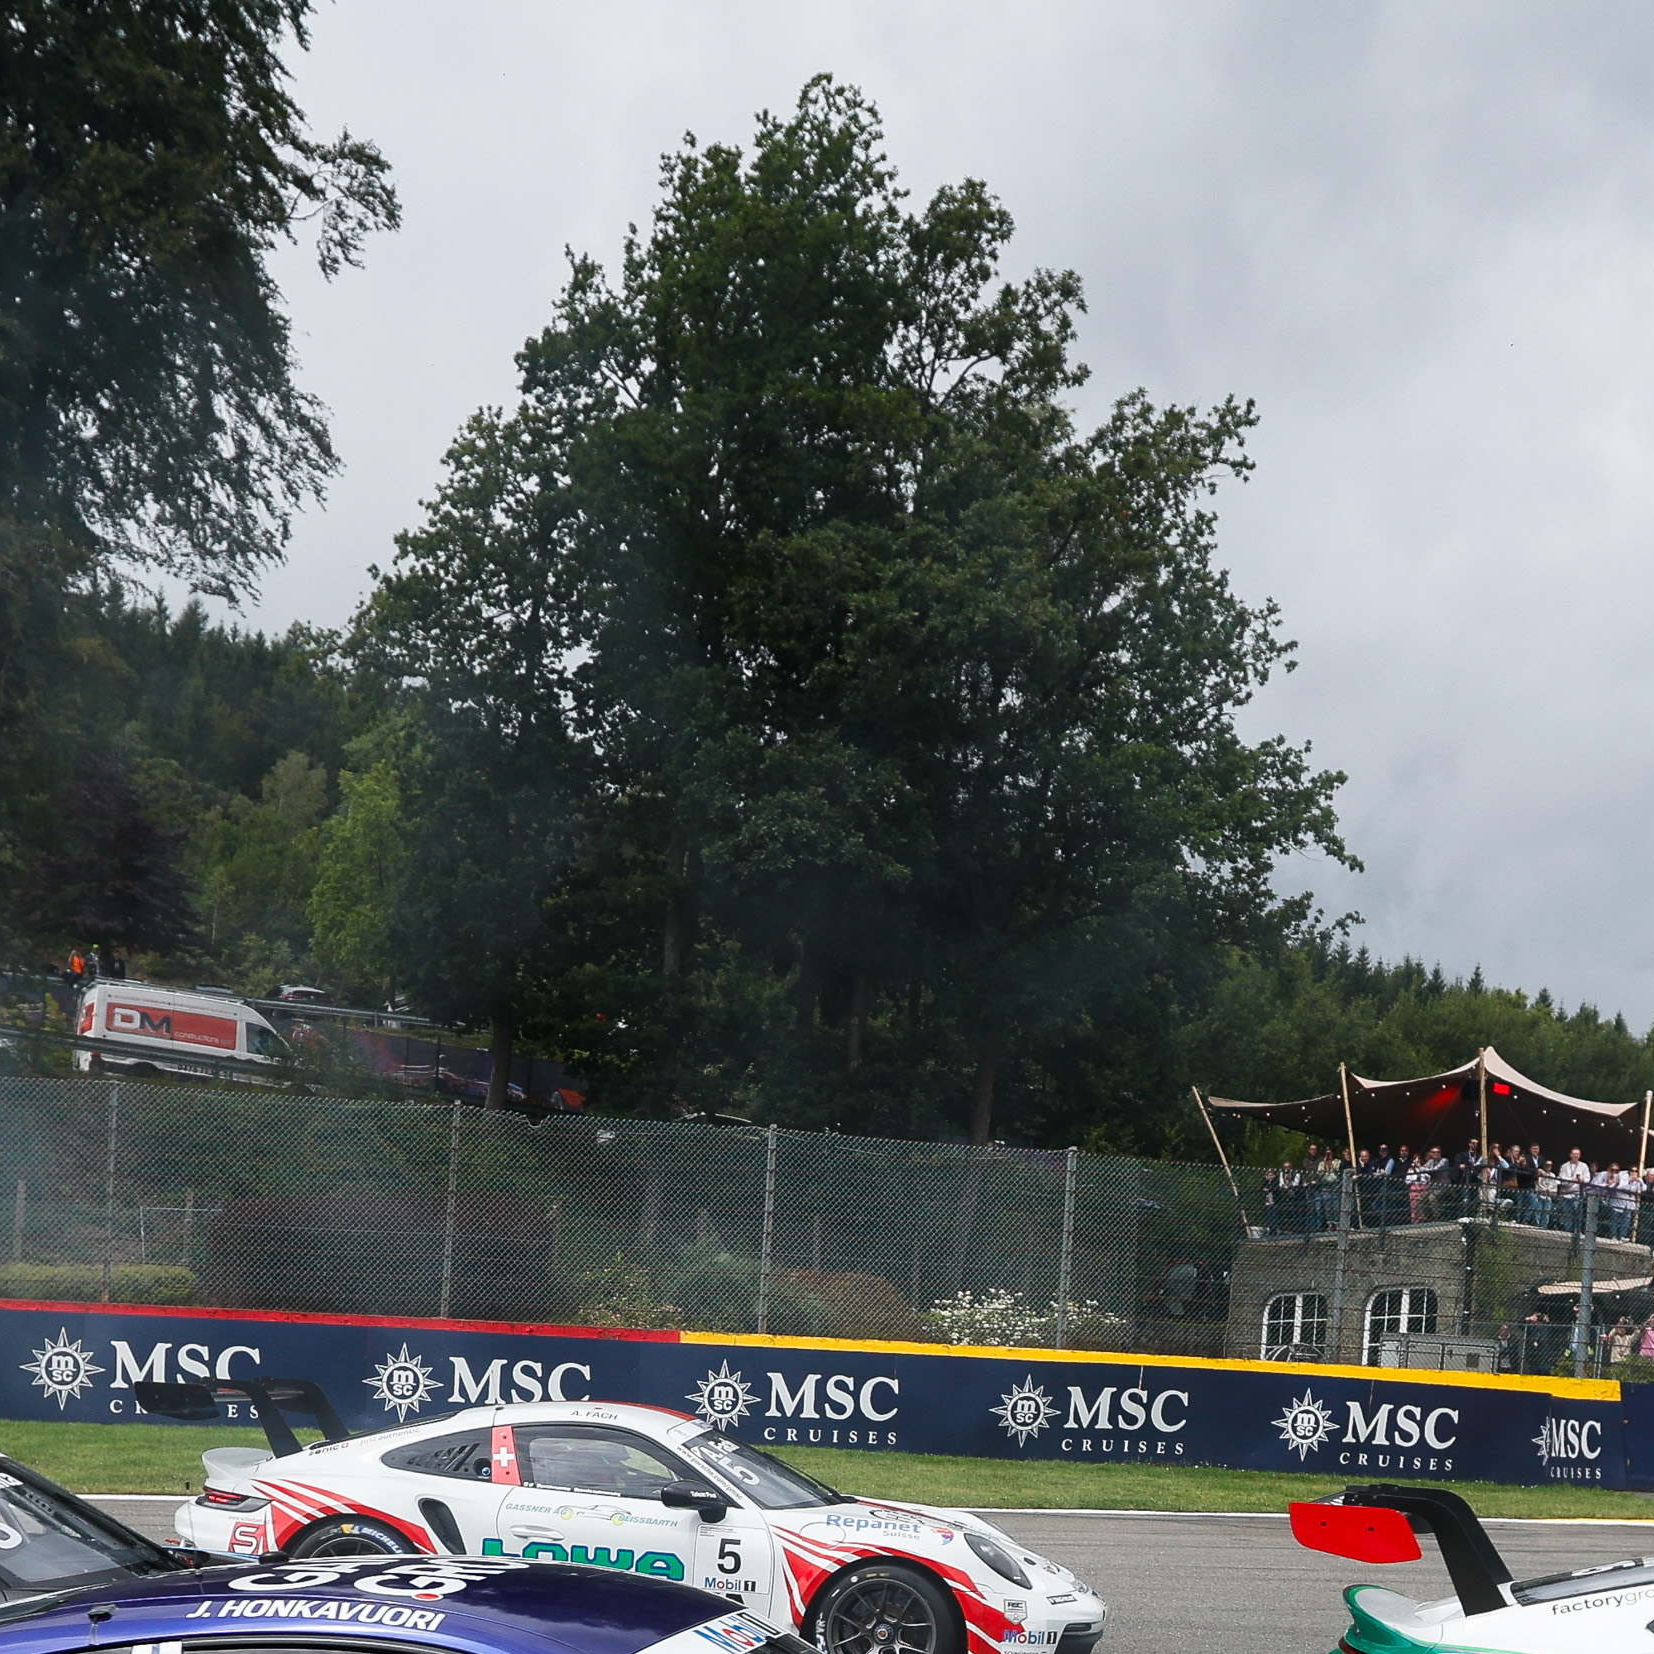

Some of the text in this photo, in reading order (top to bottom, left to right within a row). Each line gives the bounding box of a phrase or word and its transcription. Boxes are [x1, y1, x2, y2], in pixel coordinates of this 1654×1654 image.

[113, 1007, 172, 1035] DM
[110, 1340, 261, 1388] MSC
[448, 1357, 590, 1401] MSC
[765, 1373, 898, 1421] MSC
[585, 1410, 619, 1420] FACH
[1064, 1384, 1188, 1432] MSC
[1342, 1402, 1458, 1449] MSC
[764, 1428, 896, 1444] CRUISES
[1552, 1418, 1601, 1459] MSC
[1062, 1439, 1183, 1454] CRUISES
[1340, 1453, 1452, 1470] CRUISES
[1551, 1467, 1601, 1479] CRUISES
[505, 1502, 551, 1514] GASSNER
[826, 1514, 922, 1533] Repanet
[882, 1529, 921, 1541] Suisse
[717, 1538, 742, 1575] 5
[704, 1577, 756, 1592] Mobil 1
[186, 1599, 447, 1632] J. HONKAVUORI
[1004, 1631, 1046, 1645] Mobil
